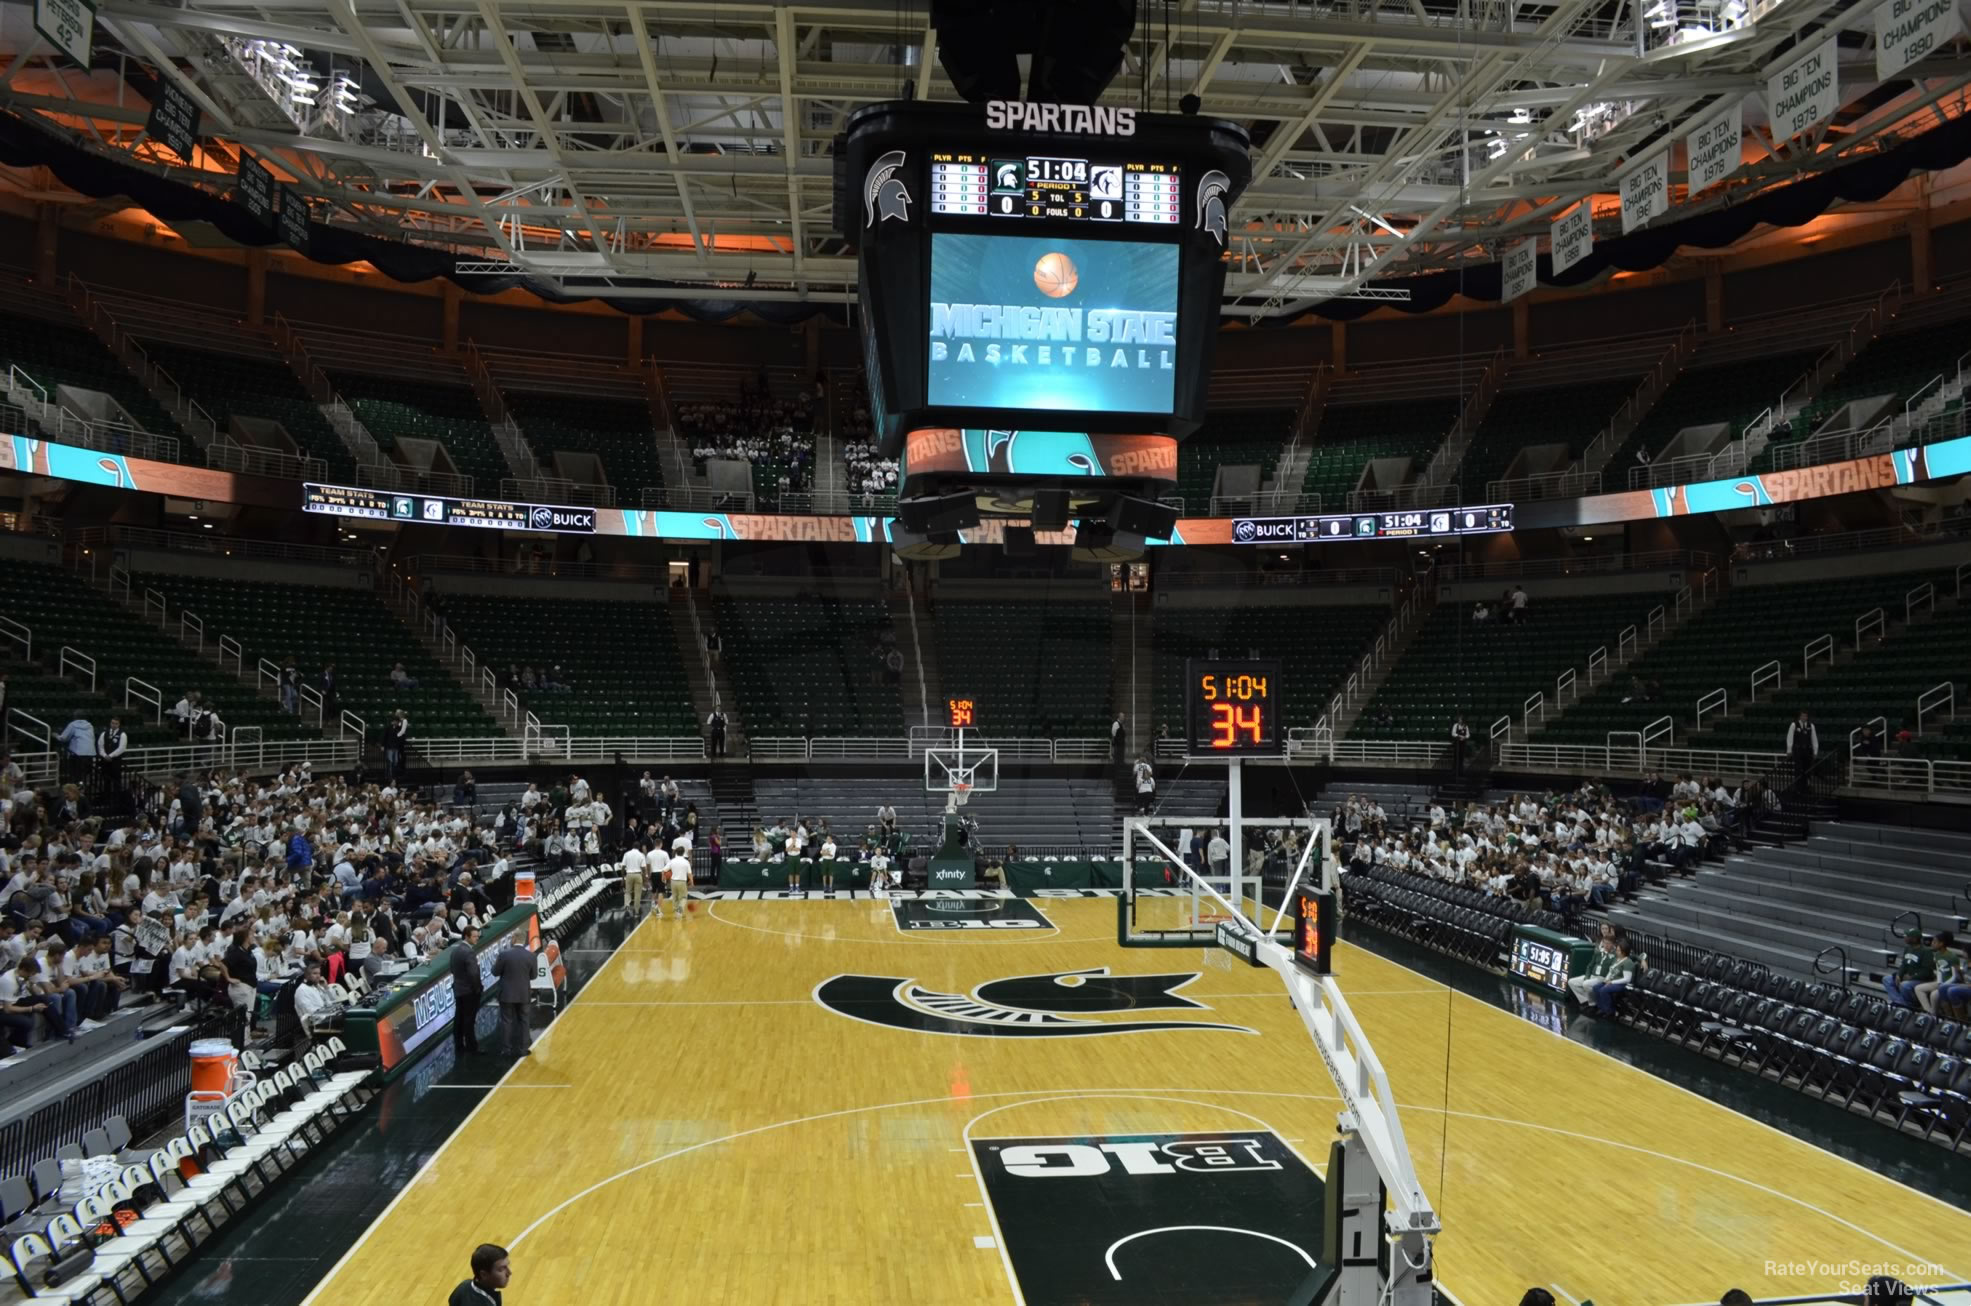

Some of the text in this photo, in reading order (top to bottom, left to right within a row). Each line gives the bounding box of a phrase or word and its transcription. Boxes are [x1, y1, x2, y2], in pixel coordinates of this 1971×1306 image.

[56, 23, 72, 50] 42
[1883, 0, 1952, 50] CHAMPIONS
[1903, 32, 1934, 64] 1990
[1783, 54, 1822, 91] BIG TEN
[1775, 71, 1832, 119] CHAMPIONS
[164, 100, 191, 130] BIG TEN
[986, 100, 1136, 137] SPARTANS
[1792, 105, 1817, 132] 1979
[155, 109, 193, 147] CHAMPIONS
[1698, 119, 1730, 150] BIG TEN
[934, 154, 952, 162] PLYR
[958, 155, 972, 163] PTS
[1690, 131, 1738, 171] CHAMPIONS
[1028, 160, 1086, 181] 51:04
[1127, 163, 1144, 171] PLYR
[1630, 163, 1658, 192] BIG TEN
[1704, 158, 1725, 182] 1978
[1002, 196, 1013, 214] 0
[1032, 191, 1082, 202] 5 TOL 5
[1623, 177, 1663, 212] CHAMPIONS
[1032, 205, 1082, 217] 0 FOULS 0
[1101, 201, 1112, 218] 0
[1559, 212, 1583, 236] BIG TEN
[1555, 223, 1589, 255] CHAMPIONS
[1518, 248, 1529, 262] TEN
[930, 303, 1177, 346] MICHIGAN STATE
[932, 342, 1173, 370] BASKETBALL
[1766, 457, 1895, 502] SPARTANS
[320, 488, 375, 499] TEAM STATS
[461, 501, 513, 511] TEAM STATS
[553, 514, 592, 527] BUICK
[732, 514, 855, 541] SPARTANS
[1257, 525, 1293, 536] BUICK
[1331, 521, 1339, 535] 0
[1385, 514, 1421, 527] 51:04
[1465, 514, 1475, 528] 0
[1203, 676, 1266, 699] 51:04
[953, 710, 970, 725] 34
[1213, 704, 1260, 747] 34
[936, 869, 966, 880] xfinity
[1530, 946, 1550, 965] 51:05
[538, 967, 546, 977] S
[1314, 1029, 1360, 1126] msuspartans.com
